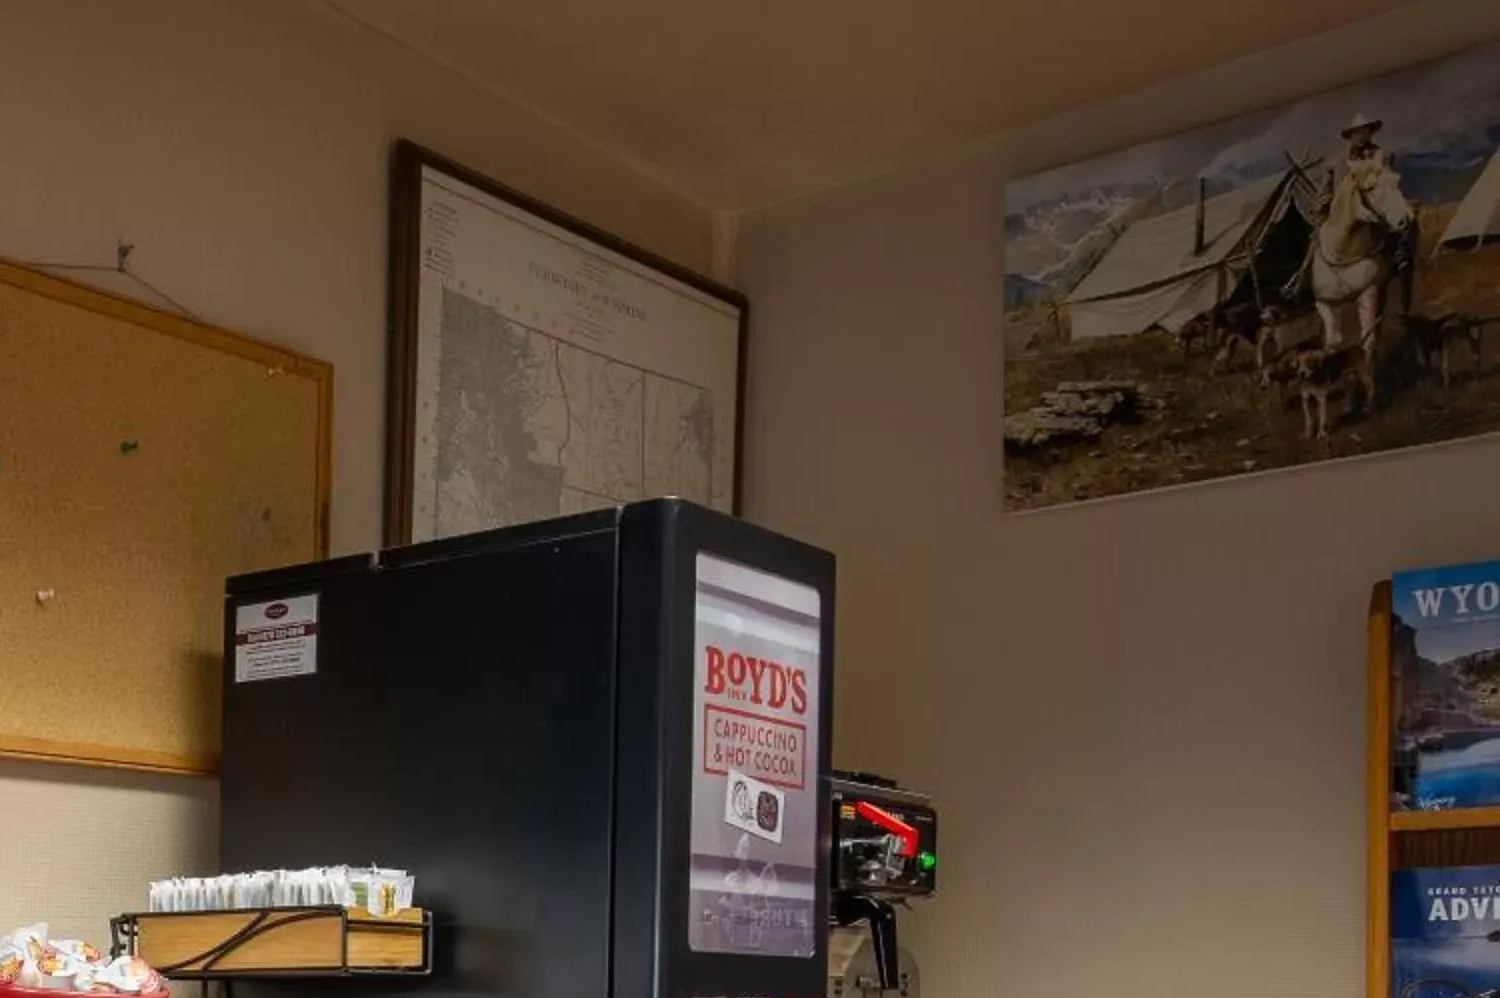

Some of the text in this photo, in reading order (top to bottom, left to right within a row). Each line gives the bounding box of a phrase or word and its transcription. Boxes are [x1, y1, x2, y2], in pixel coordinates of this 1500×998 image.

[1412, 581, 1500, 618] WYO
[704, 645, 808, 715] BOYD'S
[713, 718, 798, 753] CAPPUCCINO
[713, 744, 797, 777] & HOT COCOA
[1427, 886, 1467, 897] GRAND
